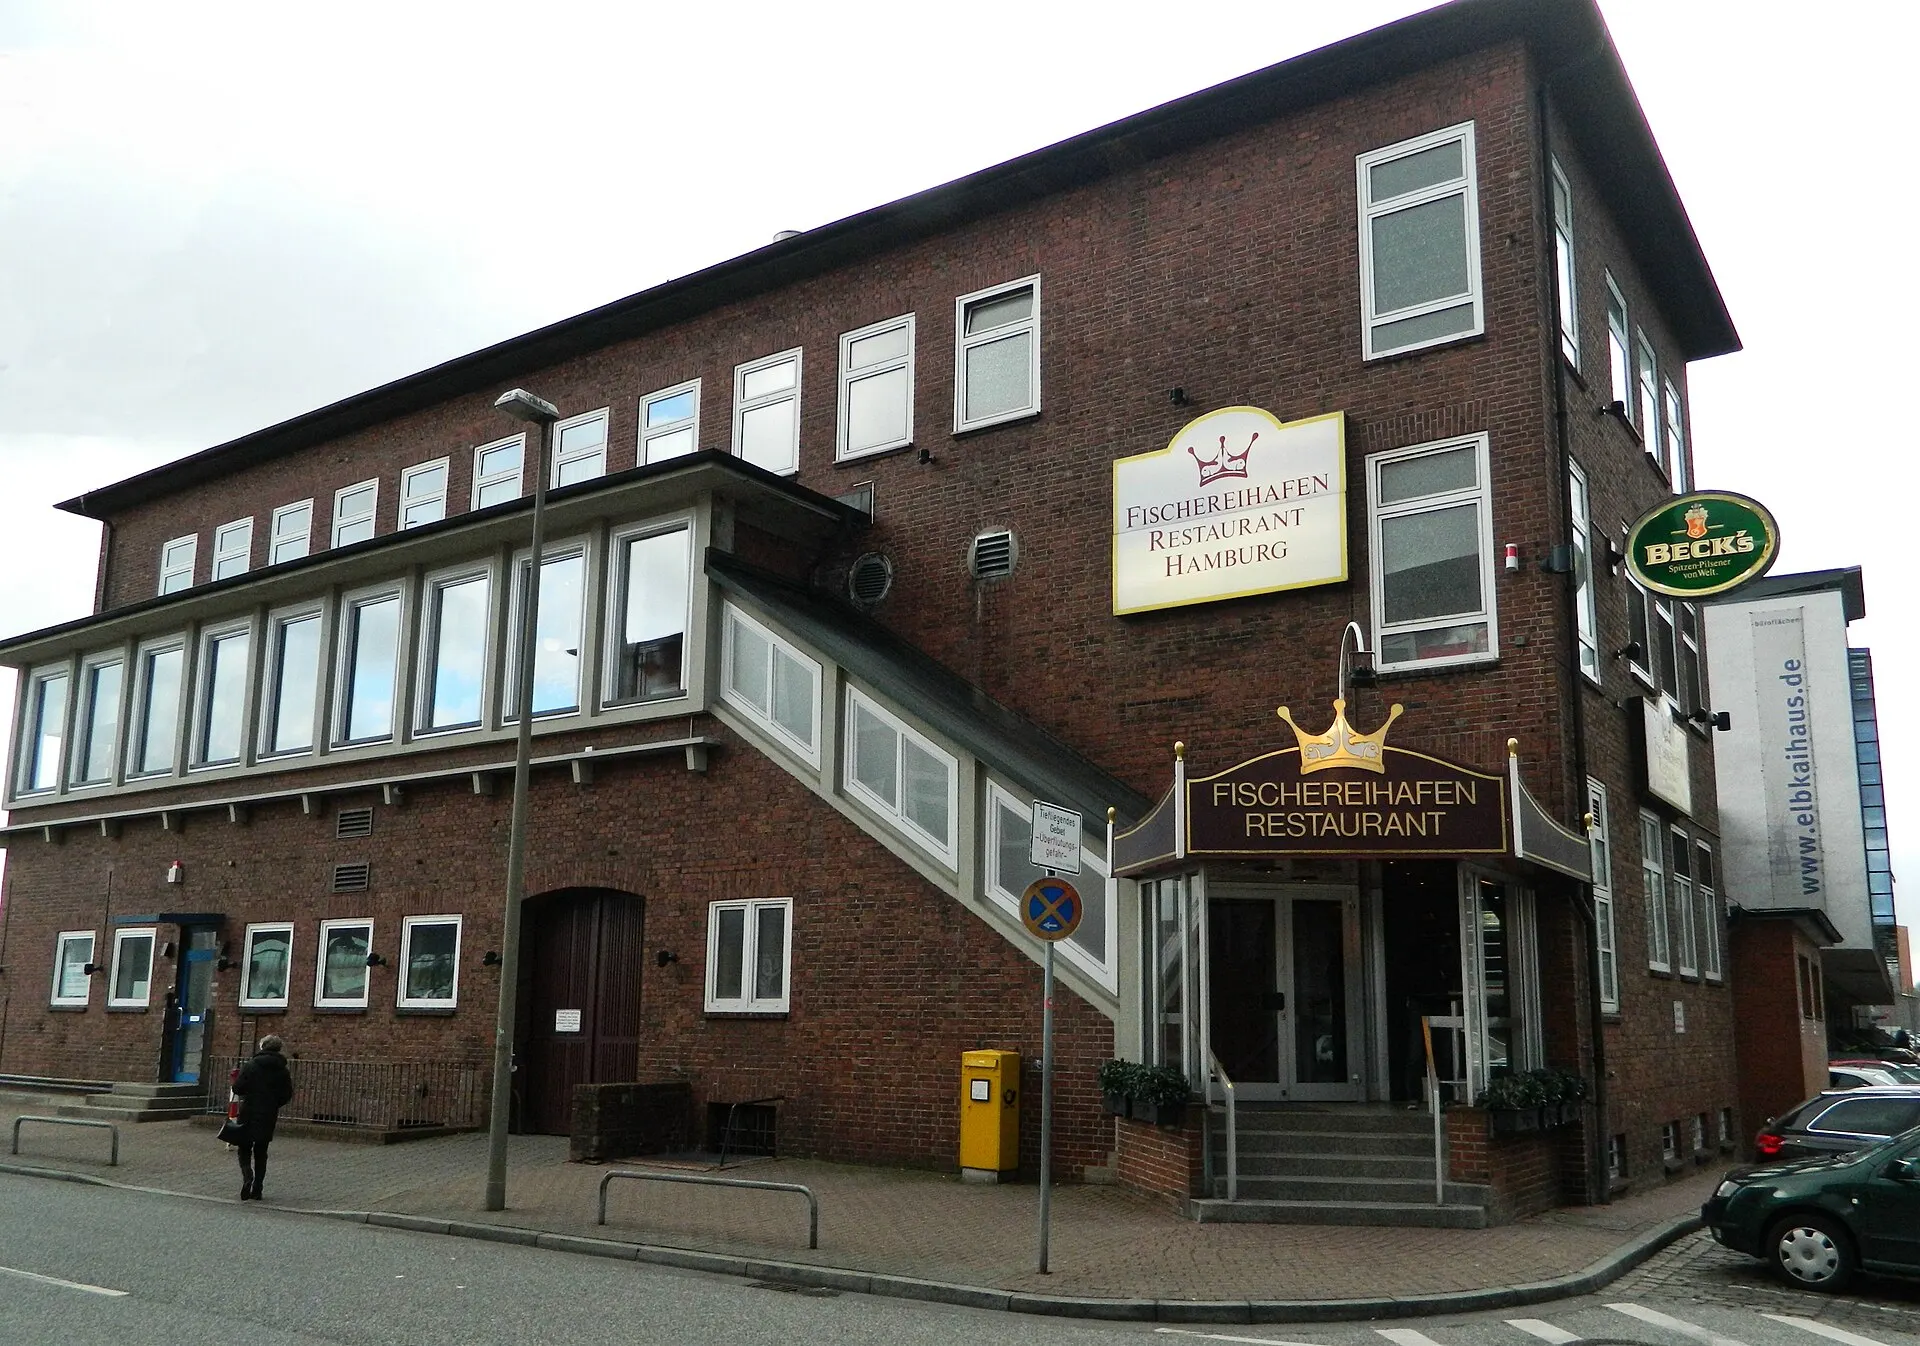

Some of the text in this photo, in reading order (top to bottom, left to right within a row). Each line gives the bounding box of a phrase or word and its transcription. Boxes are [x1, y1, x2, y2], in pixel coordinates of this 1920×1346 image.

[1126, 473, 1329, 529] FISCHEREIHAFEN
[1150, 507, 1305, 552] RESTAURANT
[1165, 541, 1288, 577] HAMBURG
[1668, 558, 1731, 573] Spitzen-Pilsener
[1683, 571, 1699, 579] von
[1779, 658, 1820, 896] www.elbkaihaus.de
[1213, 780, 1476, 806] FISCHEREIHAFEN
[1040, 808, 1075, 827] Tiefliegendes
[1049, 823, 1066, 837] Gebiet
[1245, 811, 1446, 837] RESTAURANT
[1045, 848, 1067, 858] gefahr-
